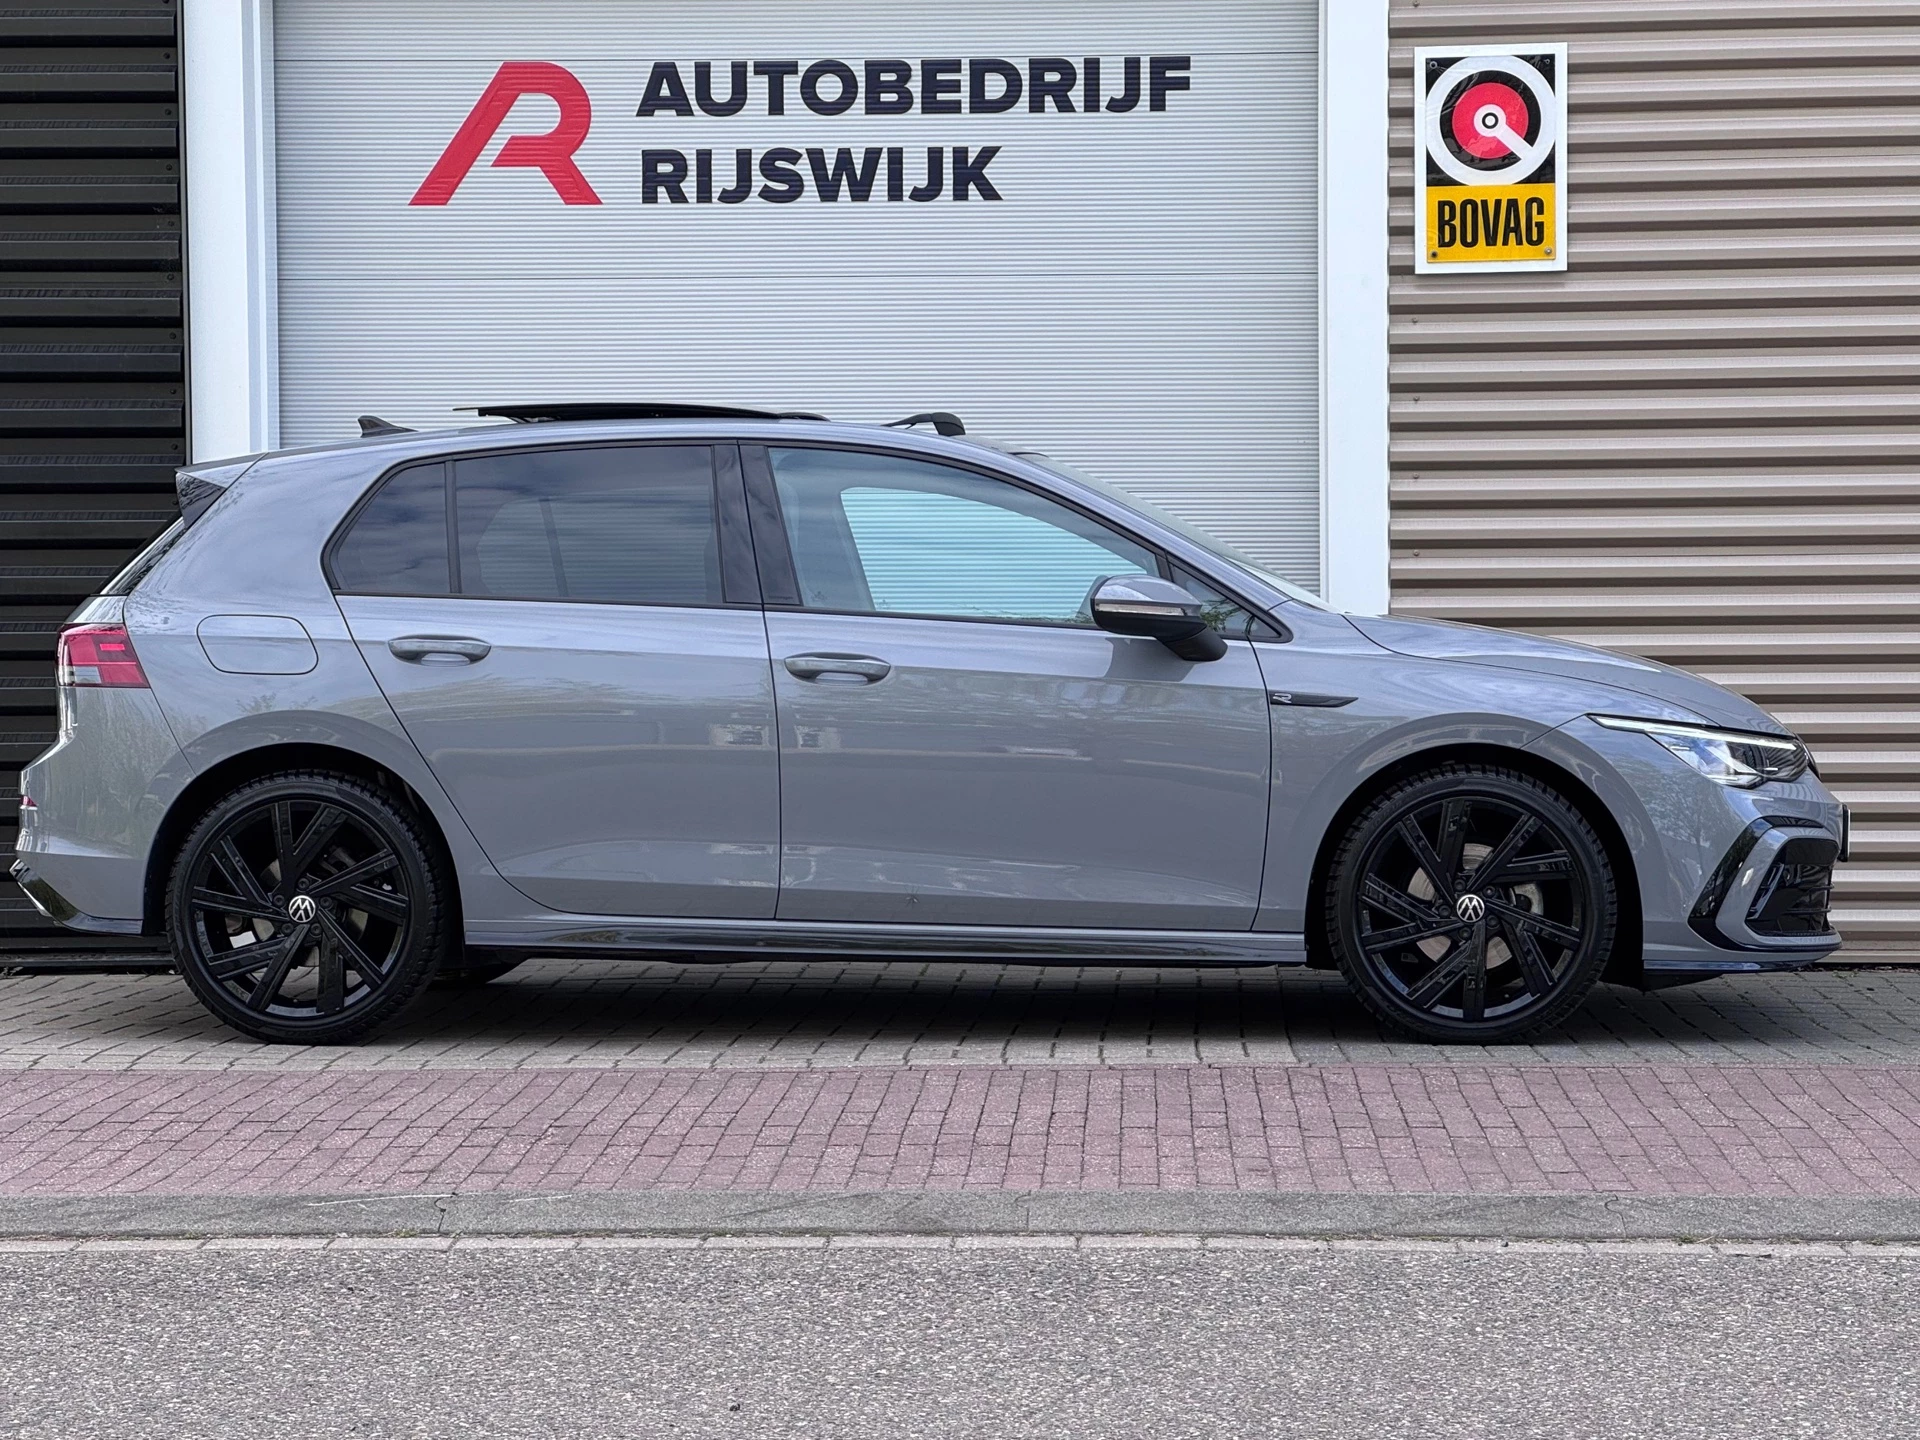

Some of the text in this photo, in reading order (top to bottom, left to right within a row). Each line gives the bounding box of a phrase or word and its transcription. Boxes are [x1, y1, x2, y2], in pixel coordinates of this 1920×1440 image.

[636, 56, 1190, 117] AUTOBEDRIJF
[642, 146, 1003, 204] RIJSWIJK
[1438, 197, 1544, 247] BOVAG
